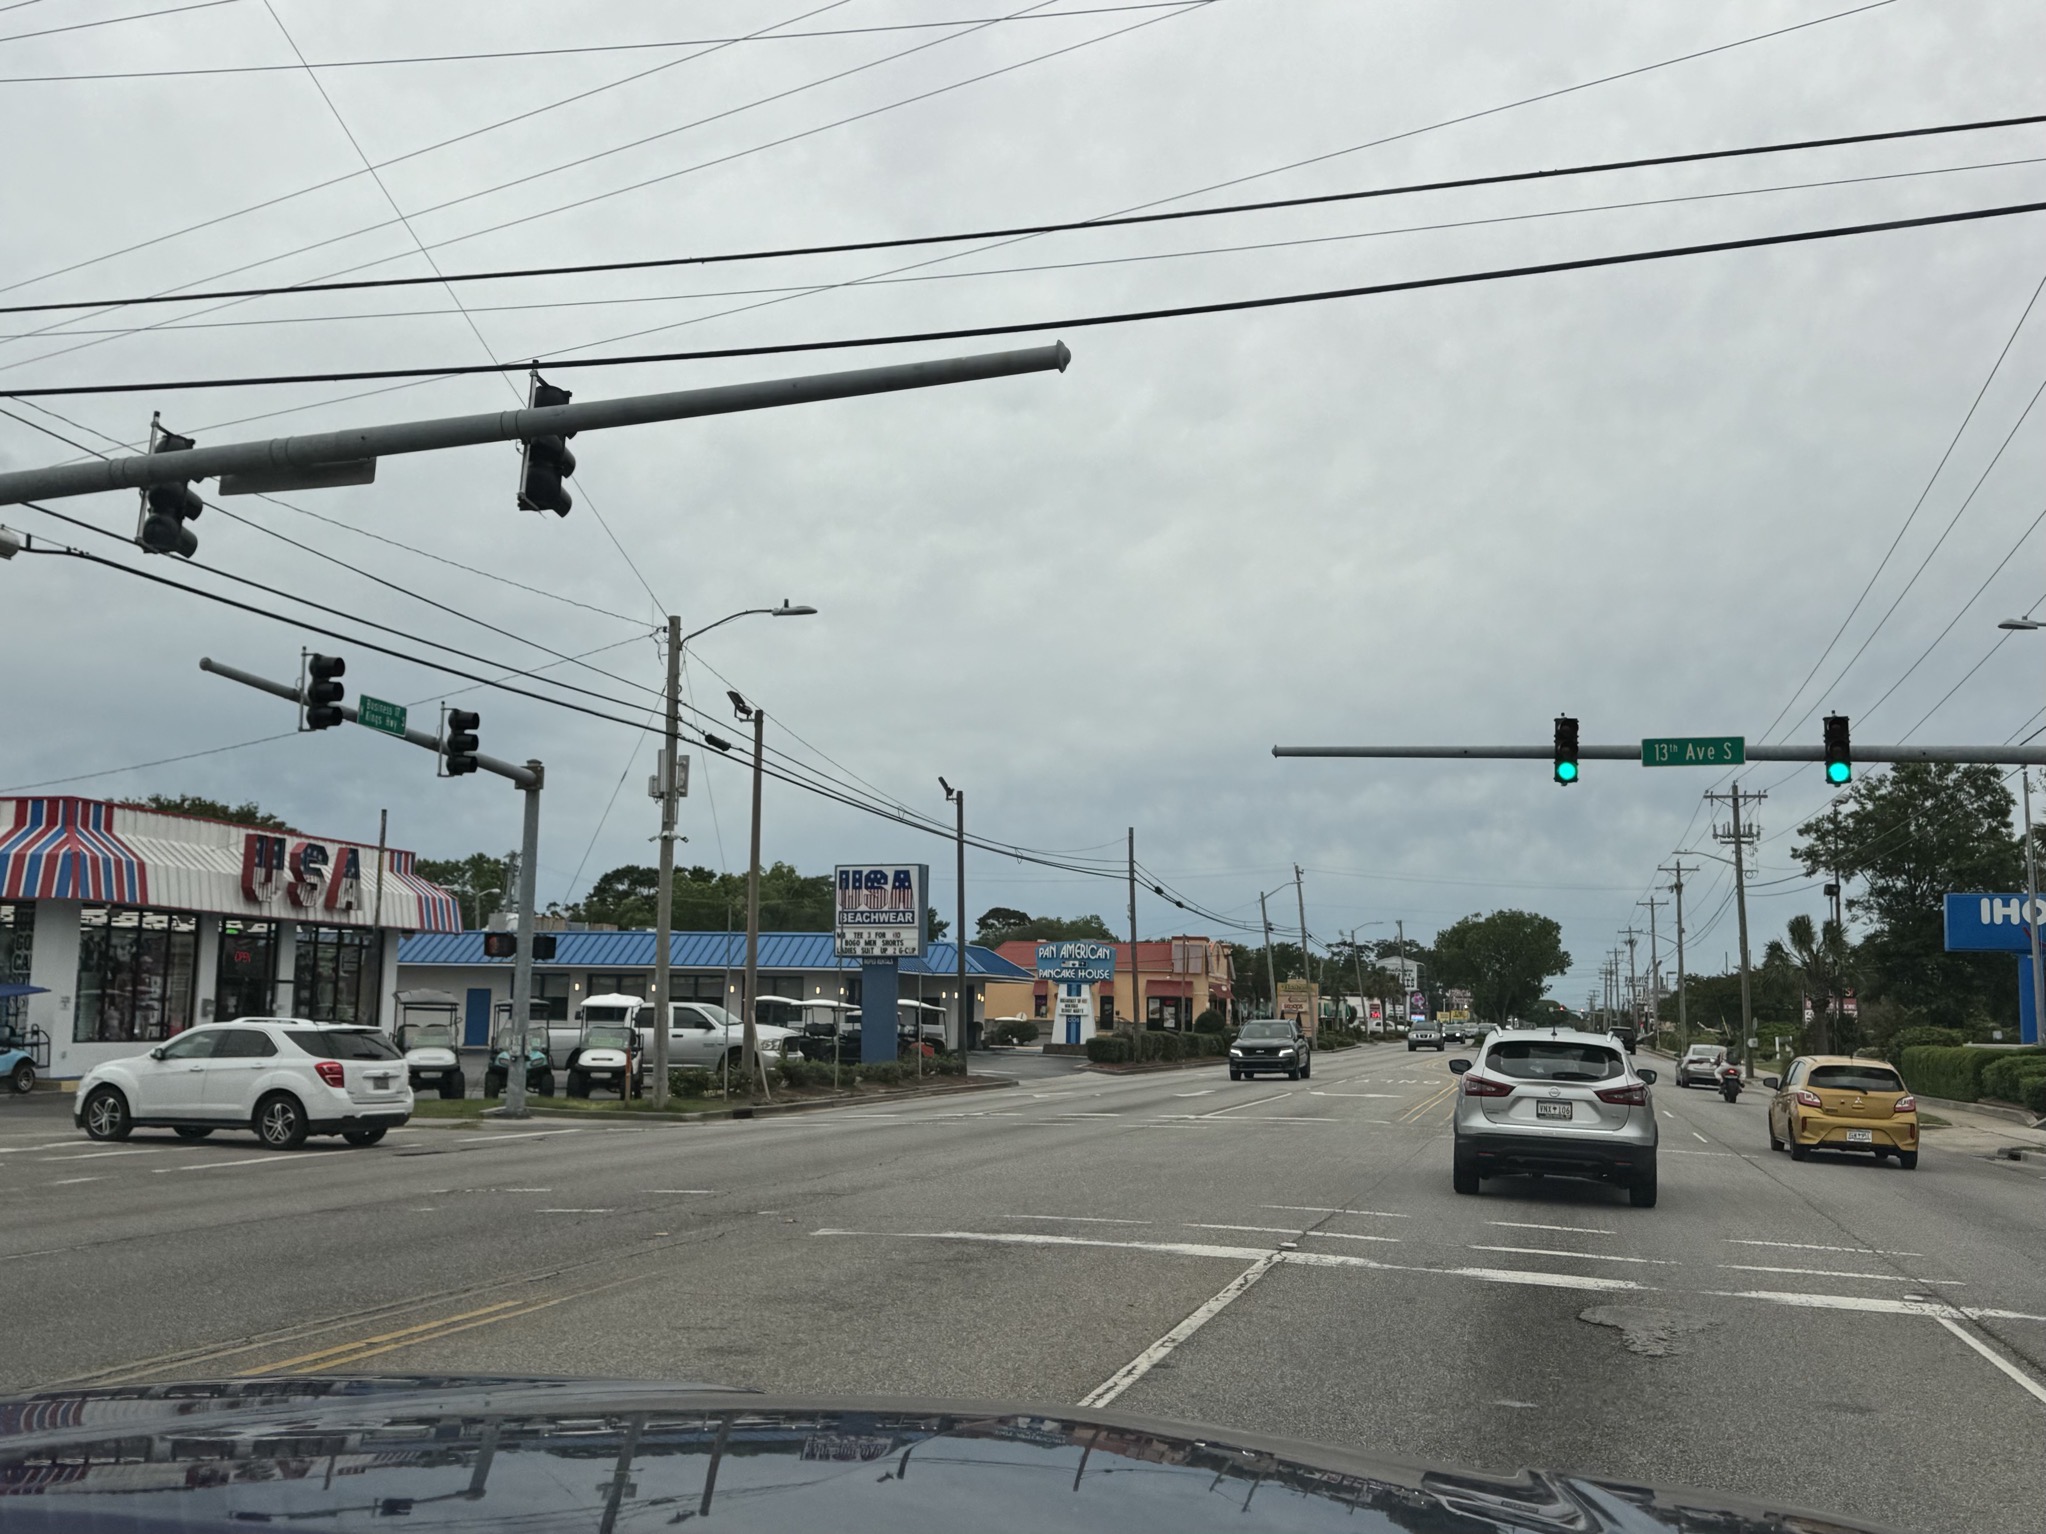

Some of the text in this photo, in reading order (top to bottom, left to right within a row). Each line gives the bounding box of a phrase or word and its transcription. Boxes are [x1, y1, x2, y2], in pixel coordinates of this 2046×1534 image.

[1654, 742, 1732, 761] 13th Ave S
[241, 834, 361, 911] USA
[838, 870, 915, 909] USA
[840, 912, 913, 923] BEACHWEAR
[1038, 943, 1110, 959] PAN AMERICAN
[1038, 968, 1110, 979] PANCAKE HOUSE
